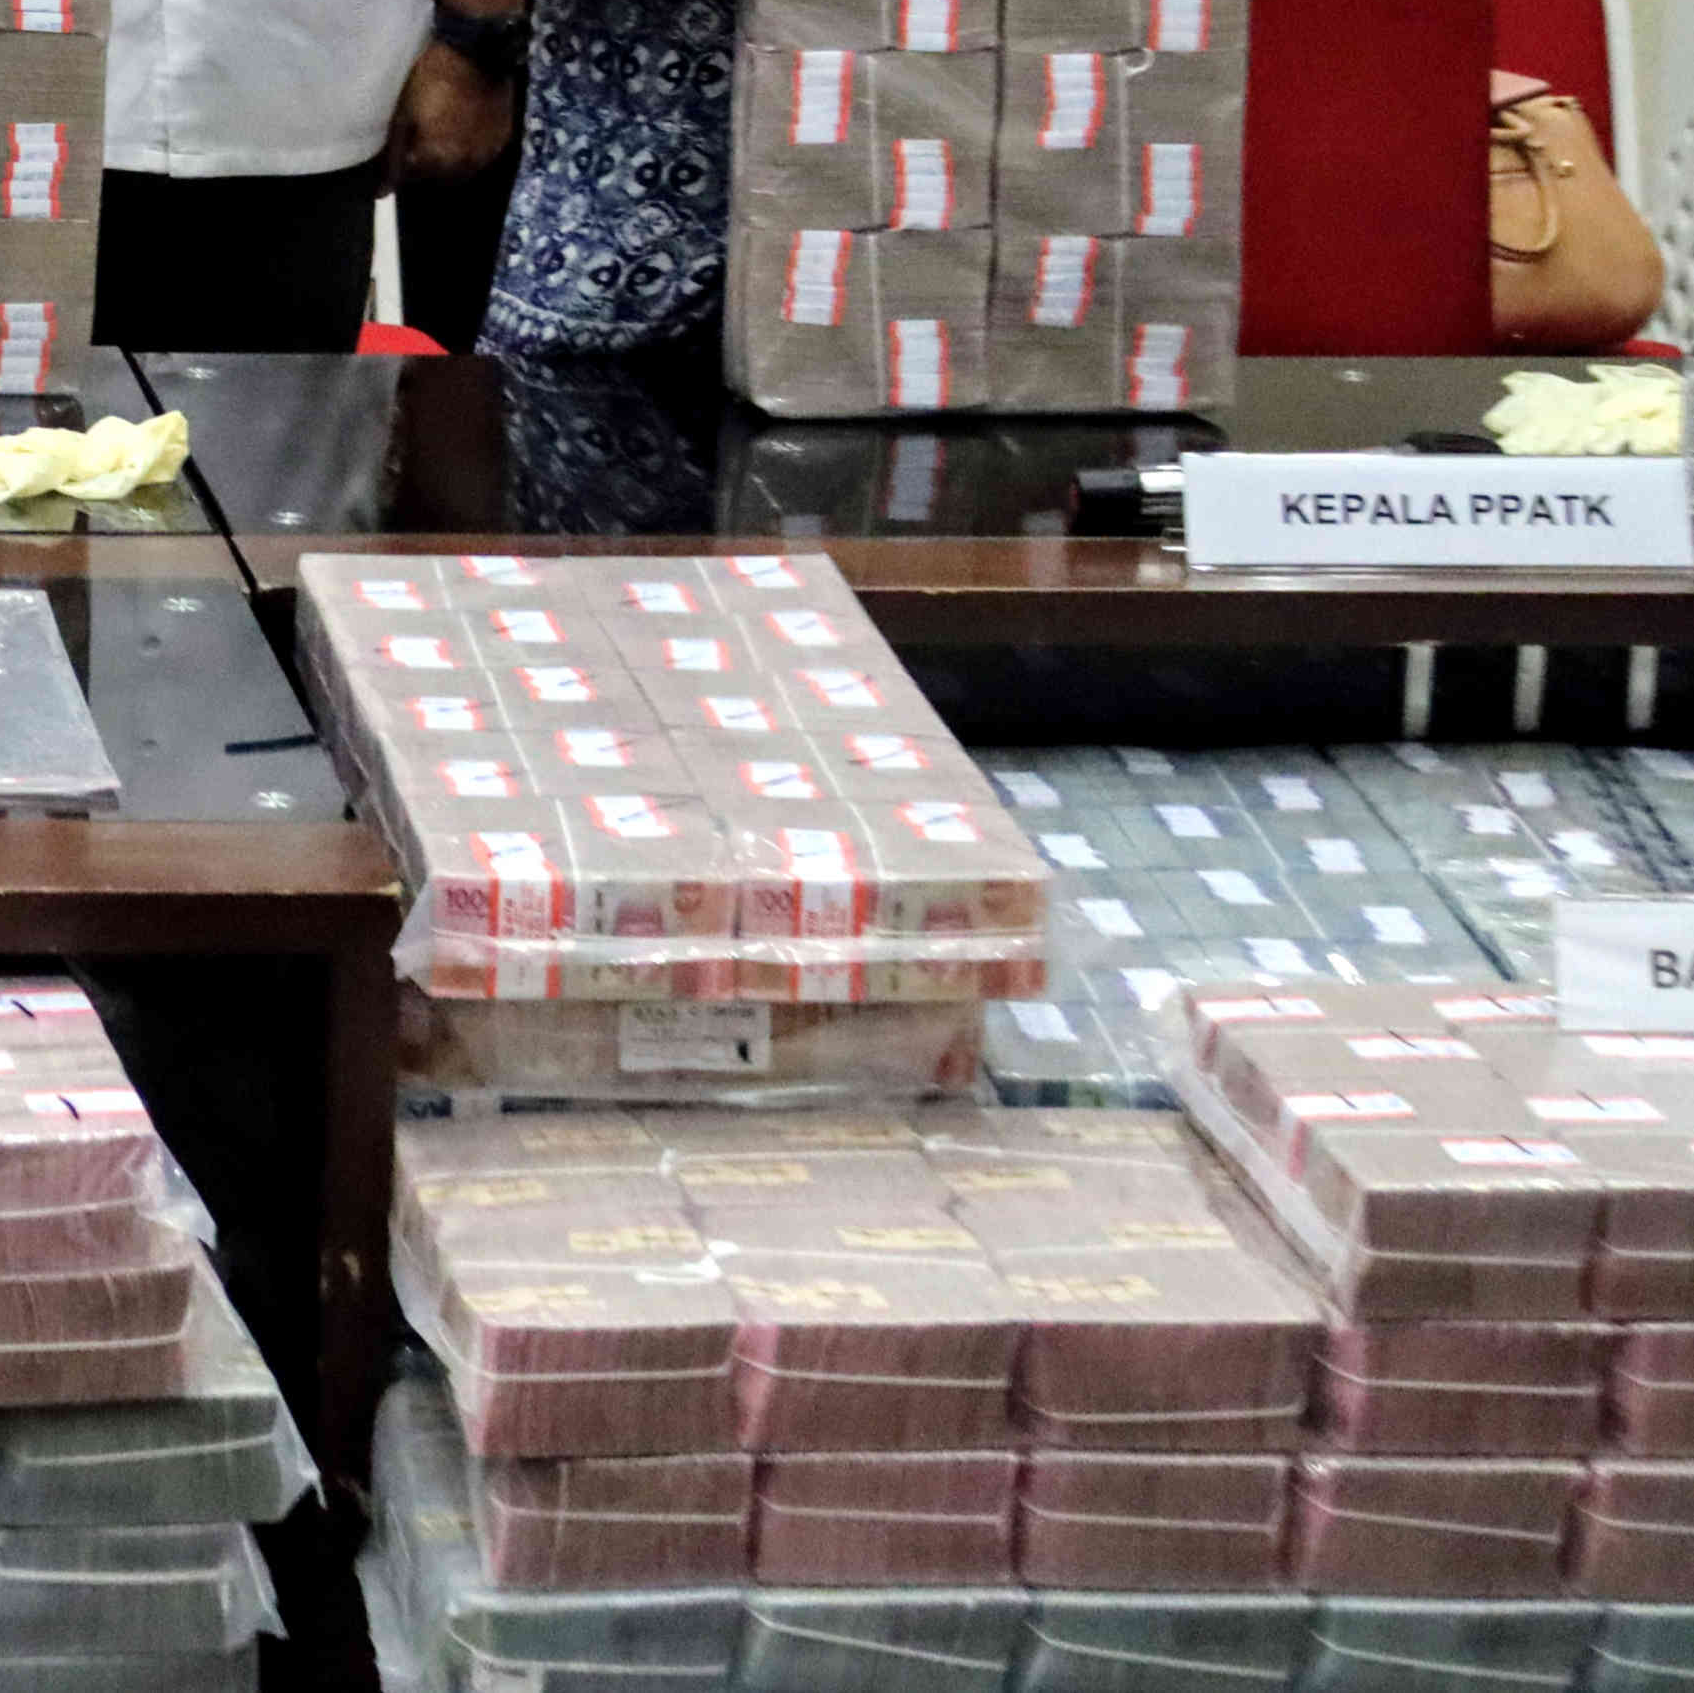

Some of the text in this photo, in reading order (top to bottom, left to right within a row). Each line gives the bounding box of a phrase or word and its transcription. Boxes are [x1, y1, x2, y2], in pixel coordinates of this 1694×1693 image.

[1282, 493, 1613, 526] KEPALA PPATK
[1651, 949, 1694, 989] B
